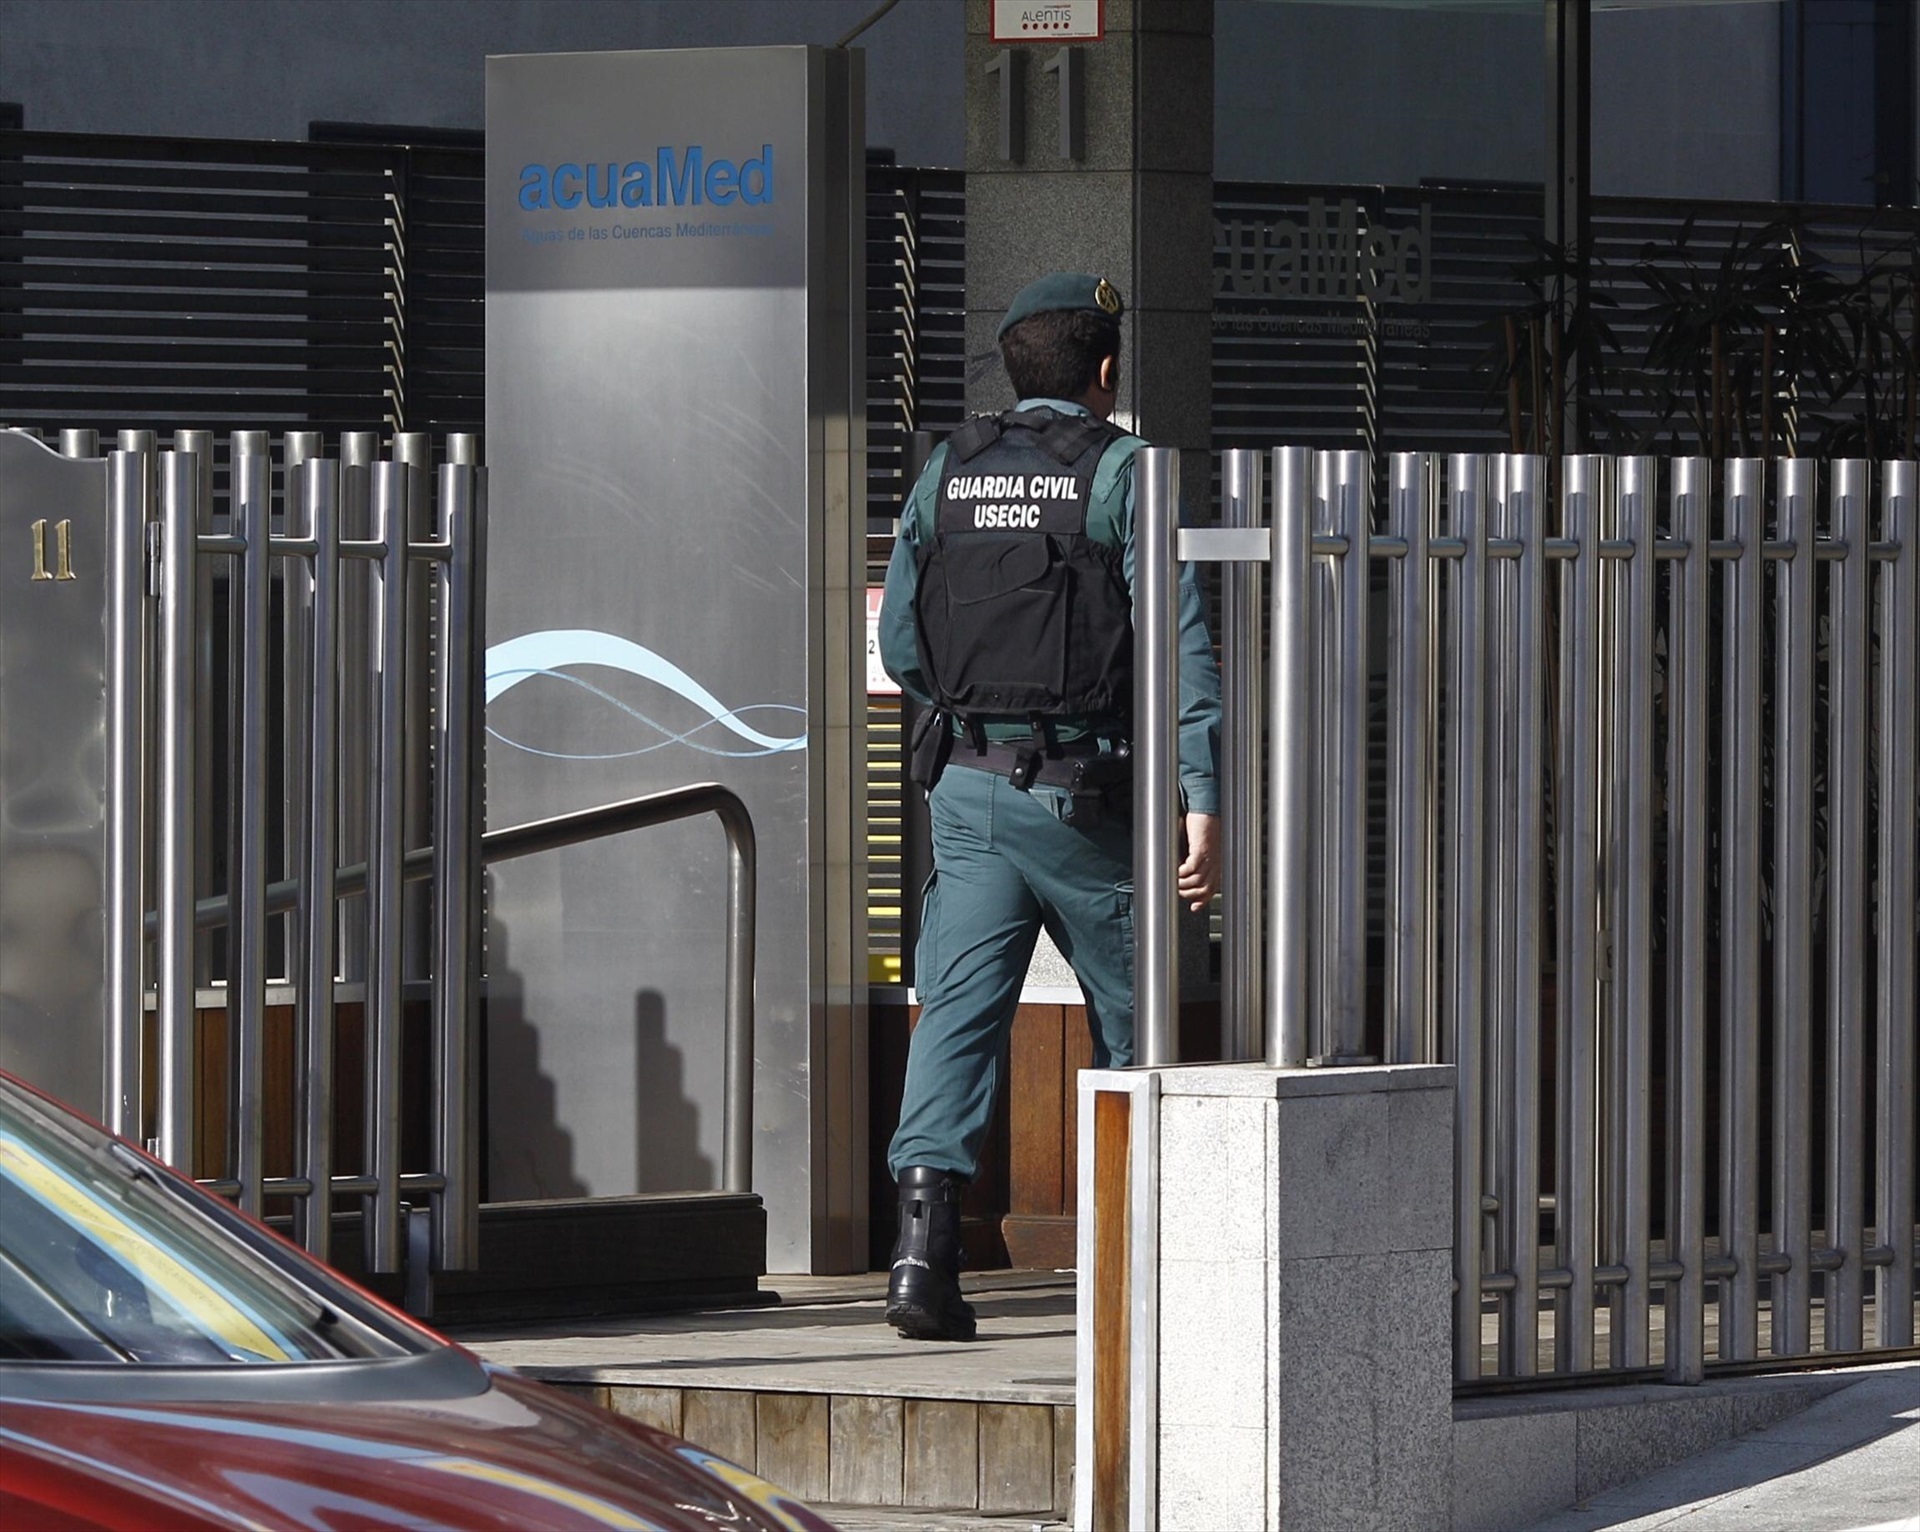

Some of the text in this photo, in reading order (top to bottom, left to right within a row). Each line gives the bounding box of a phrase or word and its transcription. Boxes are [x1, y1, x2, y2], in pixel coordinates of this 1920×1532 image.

[984, 47, 1071, 161] 11
[518, 144, 774, 211] acuaMed
[568, 225, 587, 241] de
[589, 225, 608, 240] las
[612, 224, 672, 239] Cuencas
[676, 221, 774, 238] Mediterrán
[1231, 304, 1254, 332] las
[1258, 306, 1323, 335] Cuencas
[947, 475, 1079, 500] GUARDIA CIVIL
[973, 504, 1041, 528] USECIC
[31, 518, 77, 581] 11
[868, 639, 875, 655] 2
